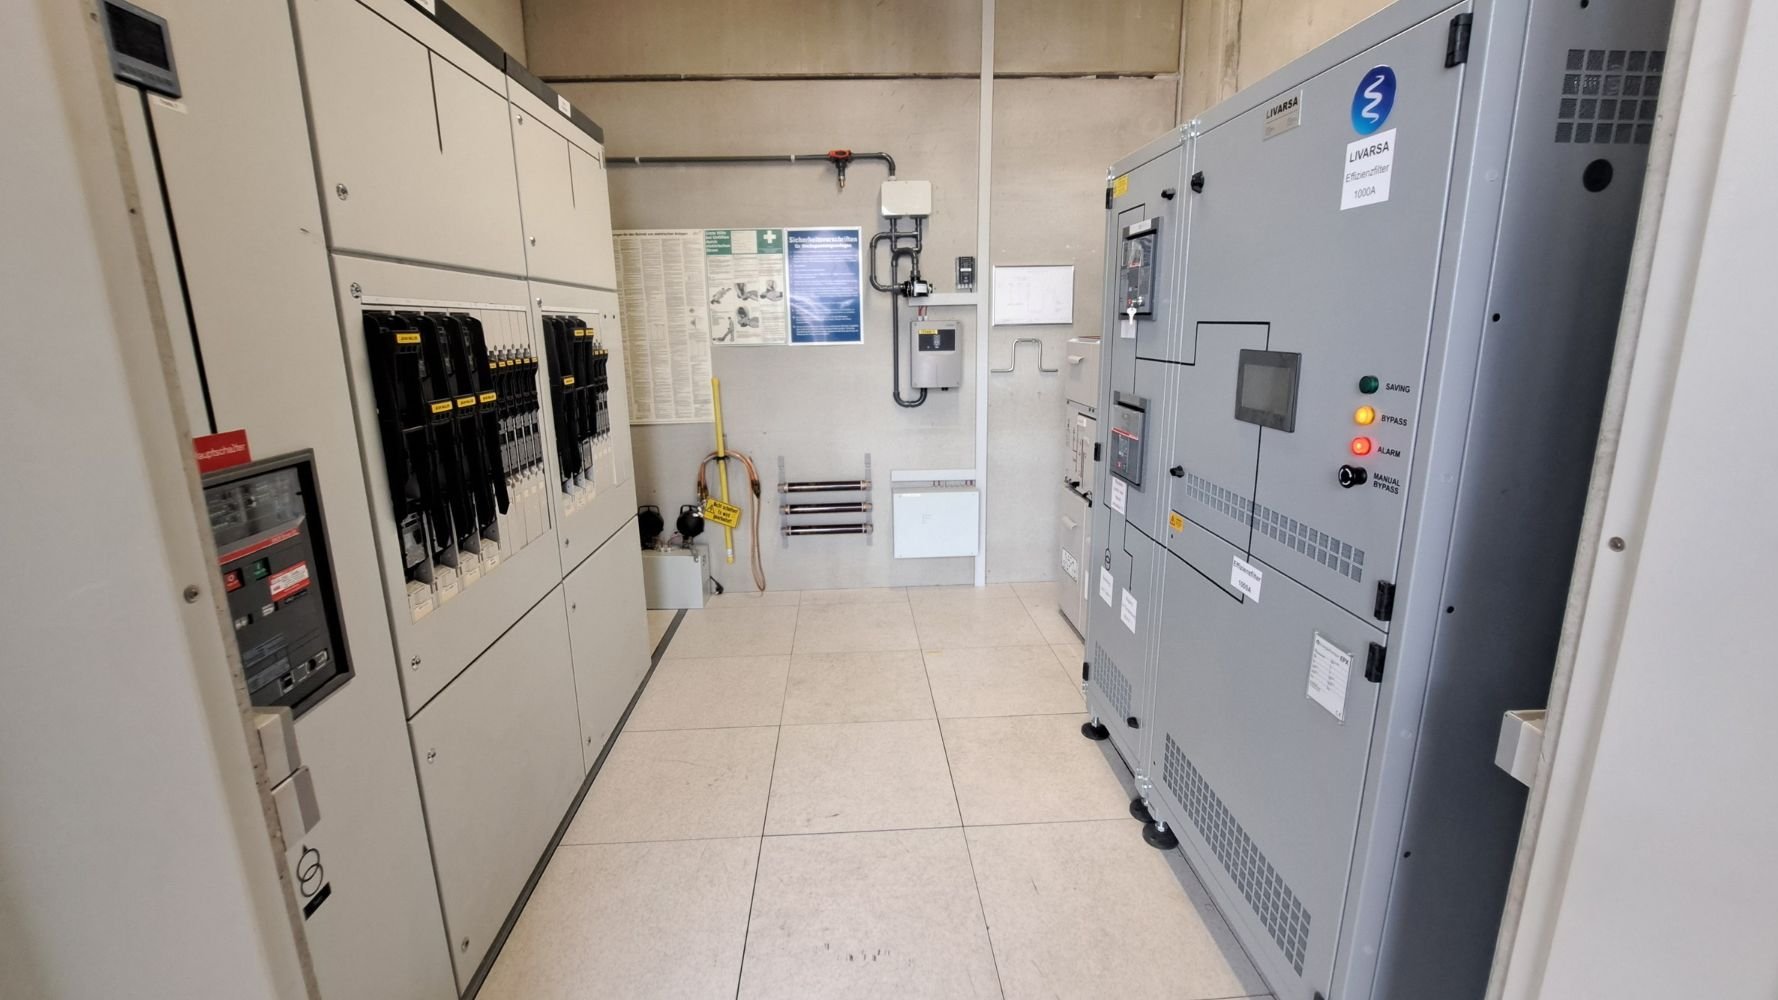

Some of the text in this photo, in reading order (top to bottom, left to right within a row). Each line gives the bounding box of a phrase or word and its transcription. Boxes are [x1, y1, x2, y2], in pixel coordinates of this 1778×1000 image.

[1265, 96, 1299, 119] LIVARSA
[1349, 141, 1390, 163] LIVARSA
[1345, 163, 1390, 183] Effizienzfilter
[1353, 186, 1376, 199] 1000A
[1385, 382, 1411, 393] SAVING
[1381, 414, 1408, 426] BYPASS
[1377, 446, 1401, 458] ALARM
[1373, 472, 1400, 487] MANUAL
[1373, 480, 1399, 495] BYPASS
